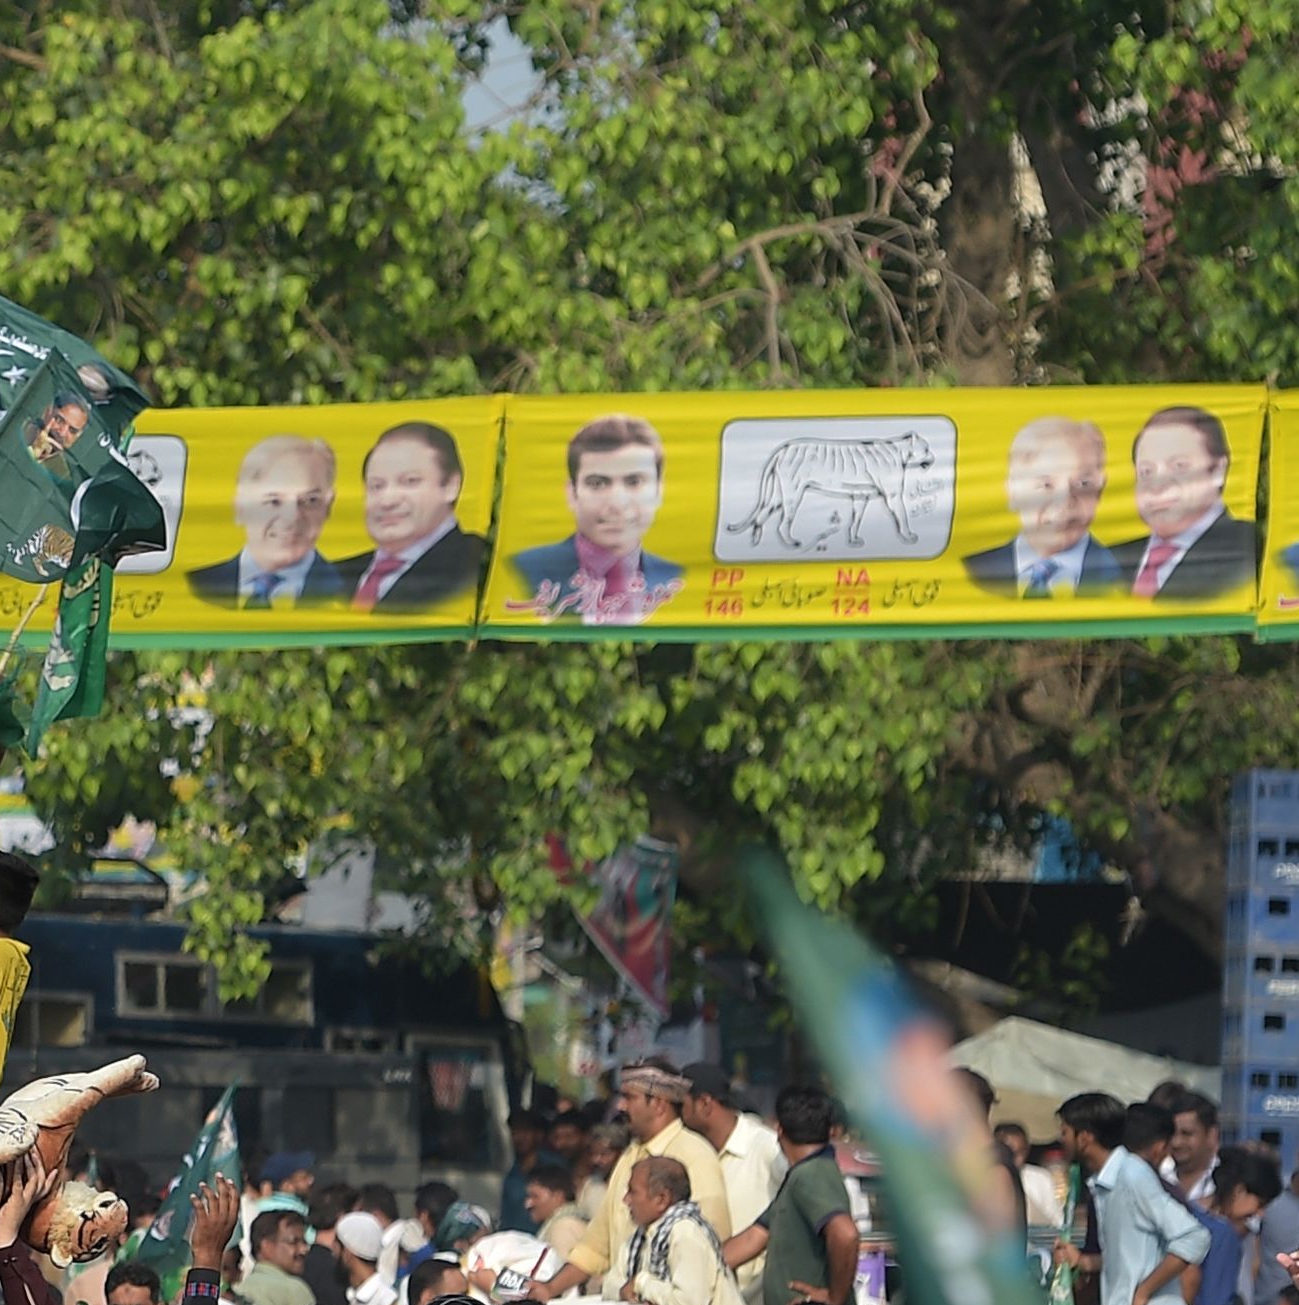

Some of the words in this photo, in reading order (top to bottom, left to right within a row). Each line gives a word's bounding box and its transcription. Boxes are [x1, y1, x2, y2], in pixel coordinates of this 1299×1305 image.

[712, 568, 744, 587] PP
[836, 567, 870, 587] NA
[705, 600, 744, 617] 146
[832, 598, 870, 617] 124
